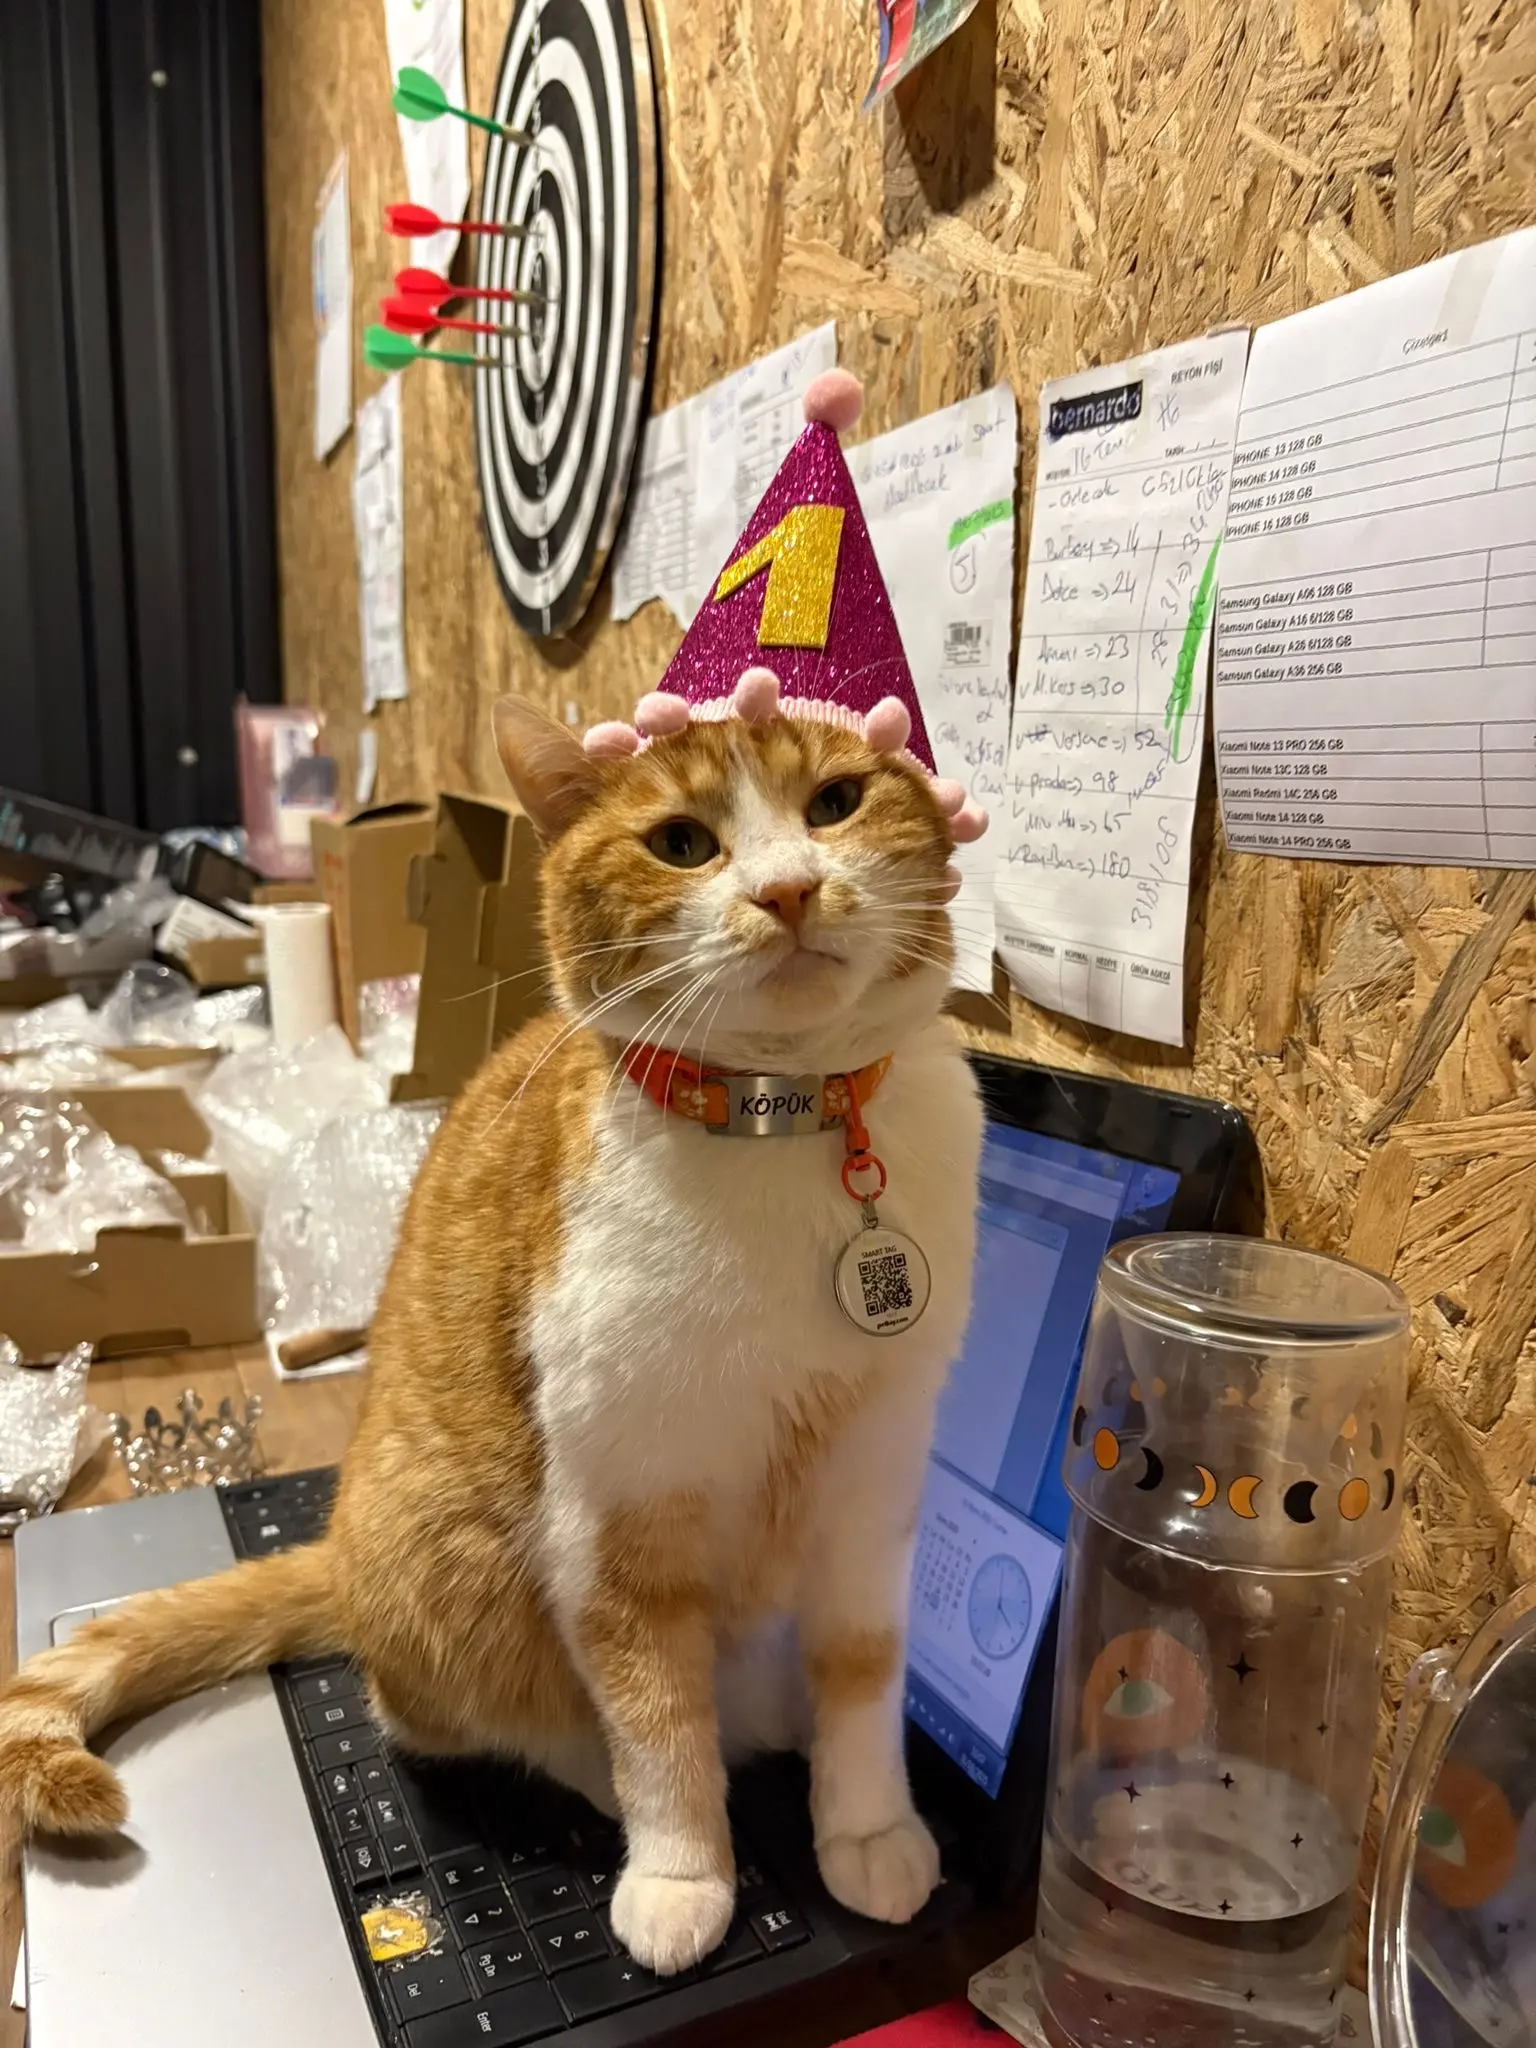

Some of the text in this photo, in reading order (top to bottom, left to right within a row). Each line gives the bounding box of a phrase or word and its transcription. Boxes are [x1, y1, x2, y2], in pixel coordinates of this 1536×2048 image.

[1171, 364, 1202, 385] REYON
[1275, 443, 1286, 456] 13
[1288, 438, 1305, 453] 128
[1307, 433, 1323, 447] GB
[1268, 469, 1280, 482] 14
[1282, 464, 1299, 479] 128
[1300, 460, 1317, 474] GB
[1266, 493, 1277, 507] 15
[1279, 489, 1295, 504] 128
[1296, 485, 1313, 500] GB
[1262, 518, 1274, 532] 16
[1275, 514, 1292, 529] 128
[1294, 511, 1310, 525] GB
[713, 502, 846, 648] 1
[1220, 596, 1260, 610] Samsung
[1262, 592, 1295, 606] Galaxy
[1317, 584, 1335, 598] 128
[1336, 582, 1353, 595] GB
[1220, 621, 1253, 634] Samsun
[1255, 618, 1287, 632] Galaxy
[1336, 608, 1353, 622] GB
[1105, 634, 1129, 660] 23
[1219, 646, 1252, 658] Samsun
[1254, 643, 1286, 657] Galaxy
[1335, 635, 1352, 648] GB
[1218, 669, 1252, 682] Samsun
[1254, 668, 1285, 682] Galaxy
[1307, 663, 1325, 676] 256
[1326, 662, 1342, 675] GB
[1099, 676, 1125, 697] 30
[1220, 741, 1248, 752] Xiaomi
[1250, 741, 1271, 752] Note
[1285, 739, 1307, 751] PRO
[1308, 739, 1326, 751] 256
[1327, 738, 1344, 750] GB
[1221, 764, 1328, 775] Xiaomi Note 13C 128 GB
[1222, 788, 1252, 798] Xiaomi
[1253, 788, 1282, 799] Redmi
[1283, 788, 1301, 799] 14C
[1321, 788, 1338, 800] GB
[1225, 811, 1325, 825] Xiaomi Note 14 128 GB
[1229, 833, 1257, 844] Xiaomi
[1258, 834, 1279, 845] Note
[1293, 836, 1315, 847] PRO
[1316, 837, 1334, 849] 256
[1335, 838, 1352, 849] GB
[1065, 949, 1089, 962] NORMAL
[740, 1092, 815, 1115] KÖPÜK
[861, 1245, 898, 1259] SMART TAG
[552, 1885, 568, 1896] 5
[574, 1929, 590, 1940] 6
[506, 1952, 522, 1963] 3
[406, 1983, 422, 1999] Del
[476, 2011, 493, 2033] Enter
